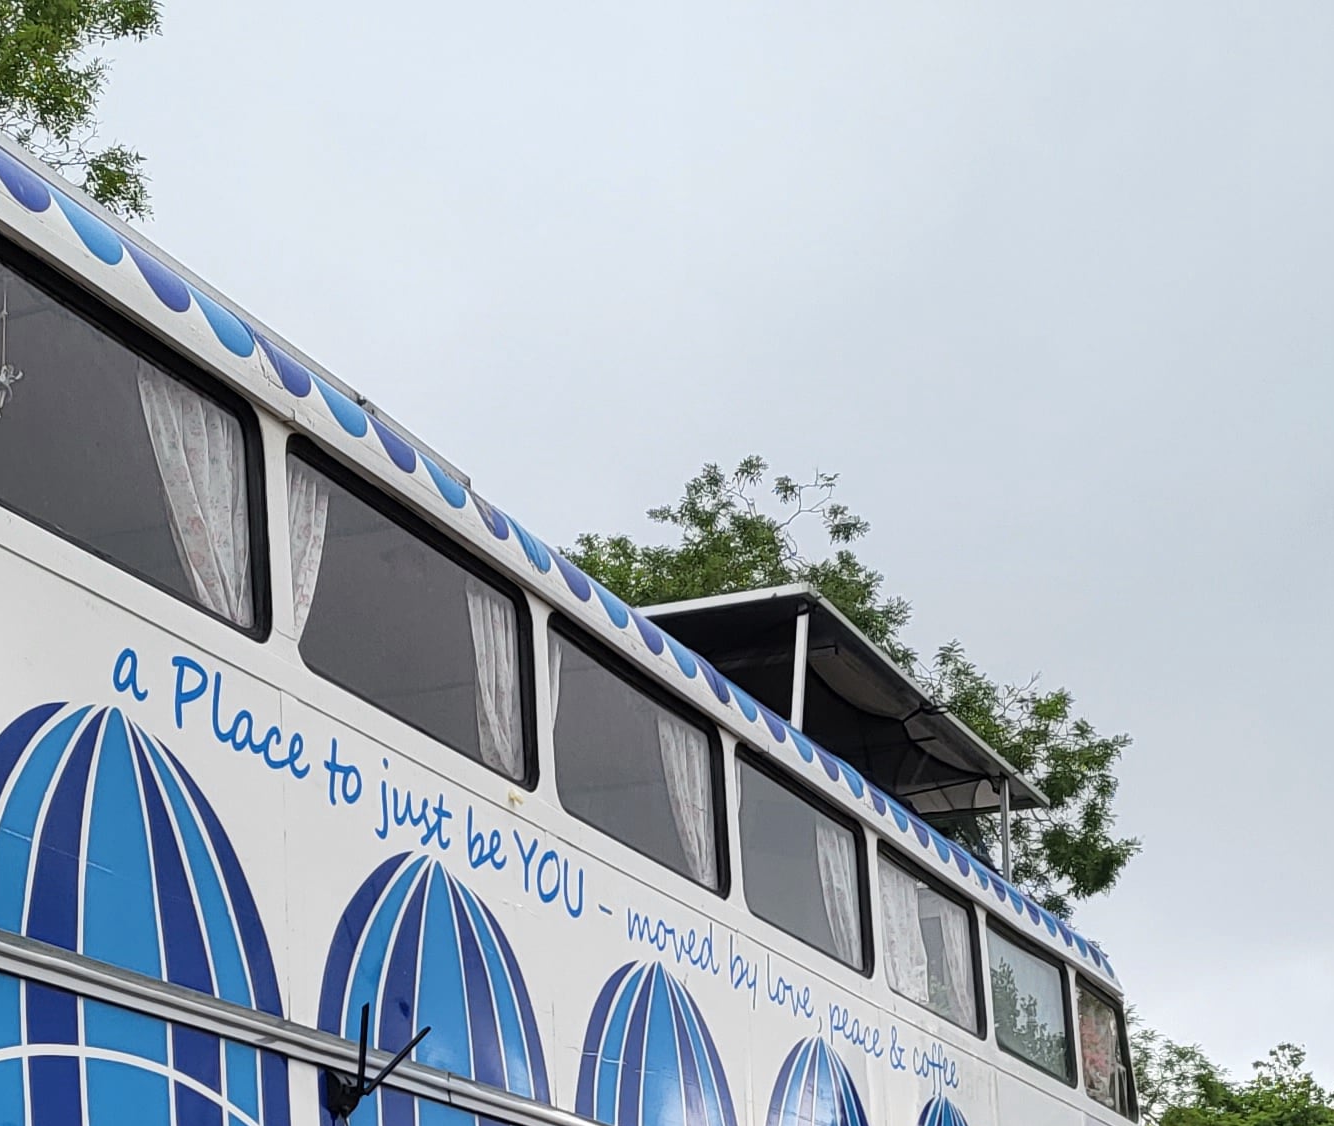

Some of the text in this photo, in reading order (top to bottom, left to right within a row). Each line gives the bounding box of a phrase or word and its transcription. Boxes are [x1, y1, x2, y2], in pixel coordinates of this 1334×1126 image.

[112, 648, 148, 701] a
[171, 656, 310, 779] Place
[324, 738, 362, 805] to
[375, 758, 452, 849] just
[468, 805, 508, 870] be
[514, 829, 584, 918] YOU
[627, 907, 720, 975] moved
[729, 933, 758, 1010] by
[829, 1002, 884, 1058] peace
[890, 1025, 906, 1070] &
[913, 1042, 960, 1097] coffee
